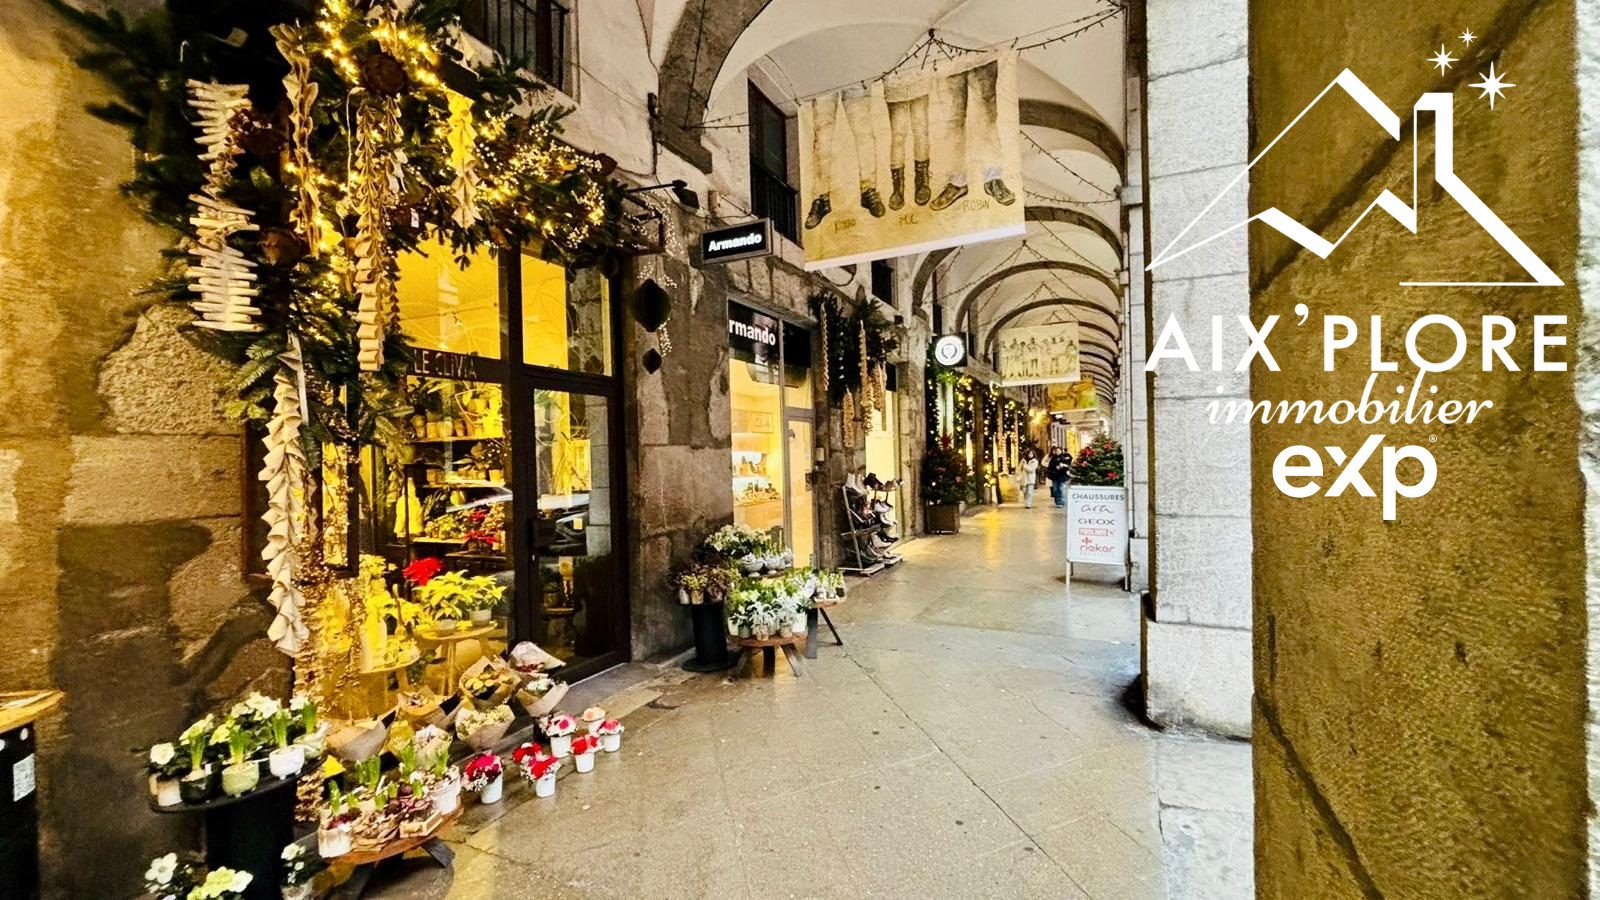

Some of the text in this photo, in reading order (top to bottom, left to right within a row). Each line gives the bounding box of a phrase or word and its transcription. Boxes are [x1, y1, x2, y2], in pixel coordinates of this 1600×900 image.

[708, 232, 763, 252] Armando
[728, 319, 776, 347] rmando
[413, 349, 430, 374] LE
[1072, 493, 1125, 501] CHAUSSURES
[1078, 518, 1115, 526] GEOX
